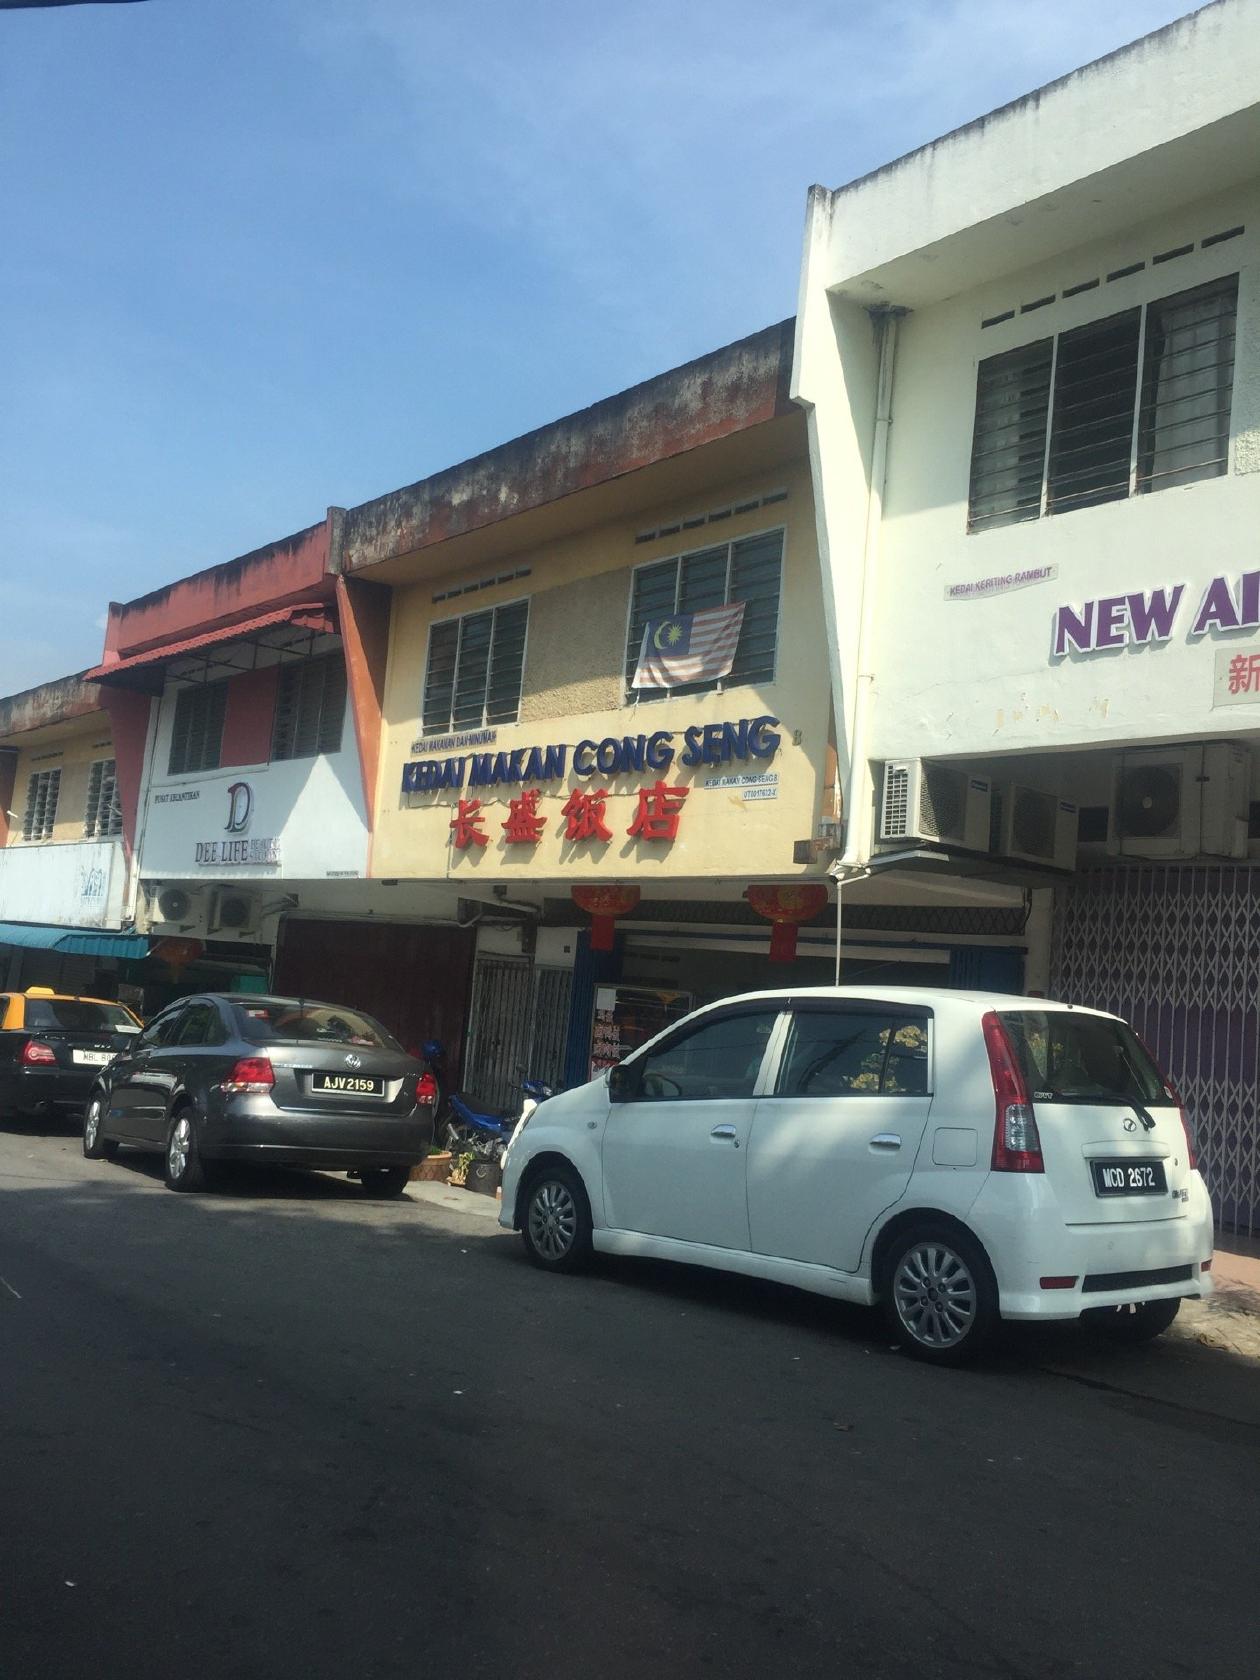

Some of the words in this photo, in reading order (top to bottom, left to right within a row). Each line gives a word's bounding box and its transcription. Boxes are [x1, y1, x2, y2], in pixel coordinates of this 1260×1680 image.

[950, 583, 973, 596] KEDAI
[975, 575, 1012, 592] KERITING
[1015, 566, 1053, 583] RAMBUT
[1053, 583, 1187, 656] NEW
[402, 756, 466, 793] KEDAI
[468, 743, 567, 786] MAKAN
[573, 731, 675, 775] CONG
[682, 715, 781, 766] SENG
[411, 742, 428, 754] KEDAI
[429, 737, 456, 751] MAKANAN
[742, 774, 757, 784] CONG
[195, 841, 217, 863] DEE
[221, 839, 249, 862] LIFE
[324, 1076, 346, 1089] AJV
[346, 1077, 374, 1092] 2159
[1102, 1167, 1124, 1187] MCD
[1128, 1166, 1156, 1187] 2672
